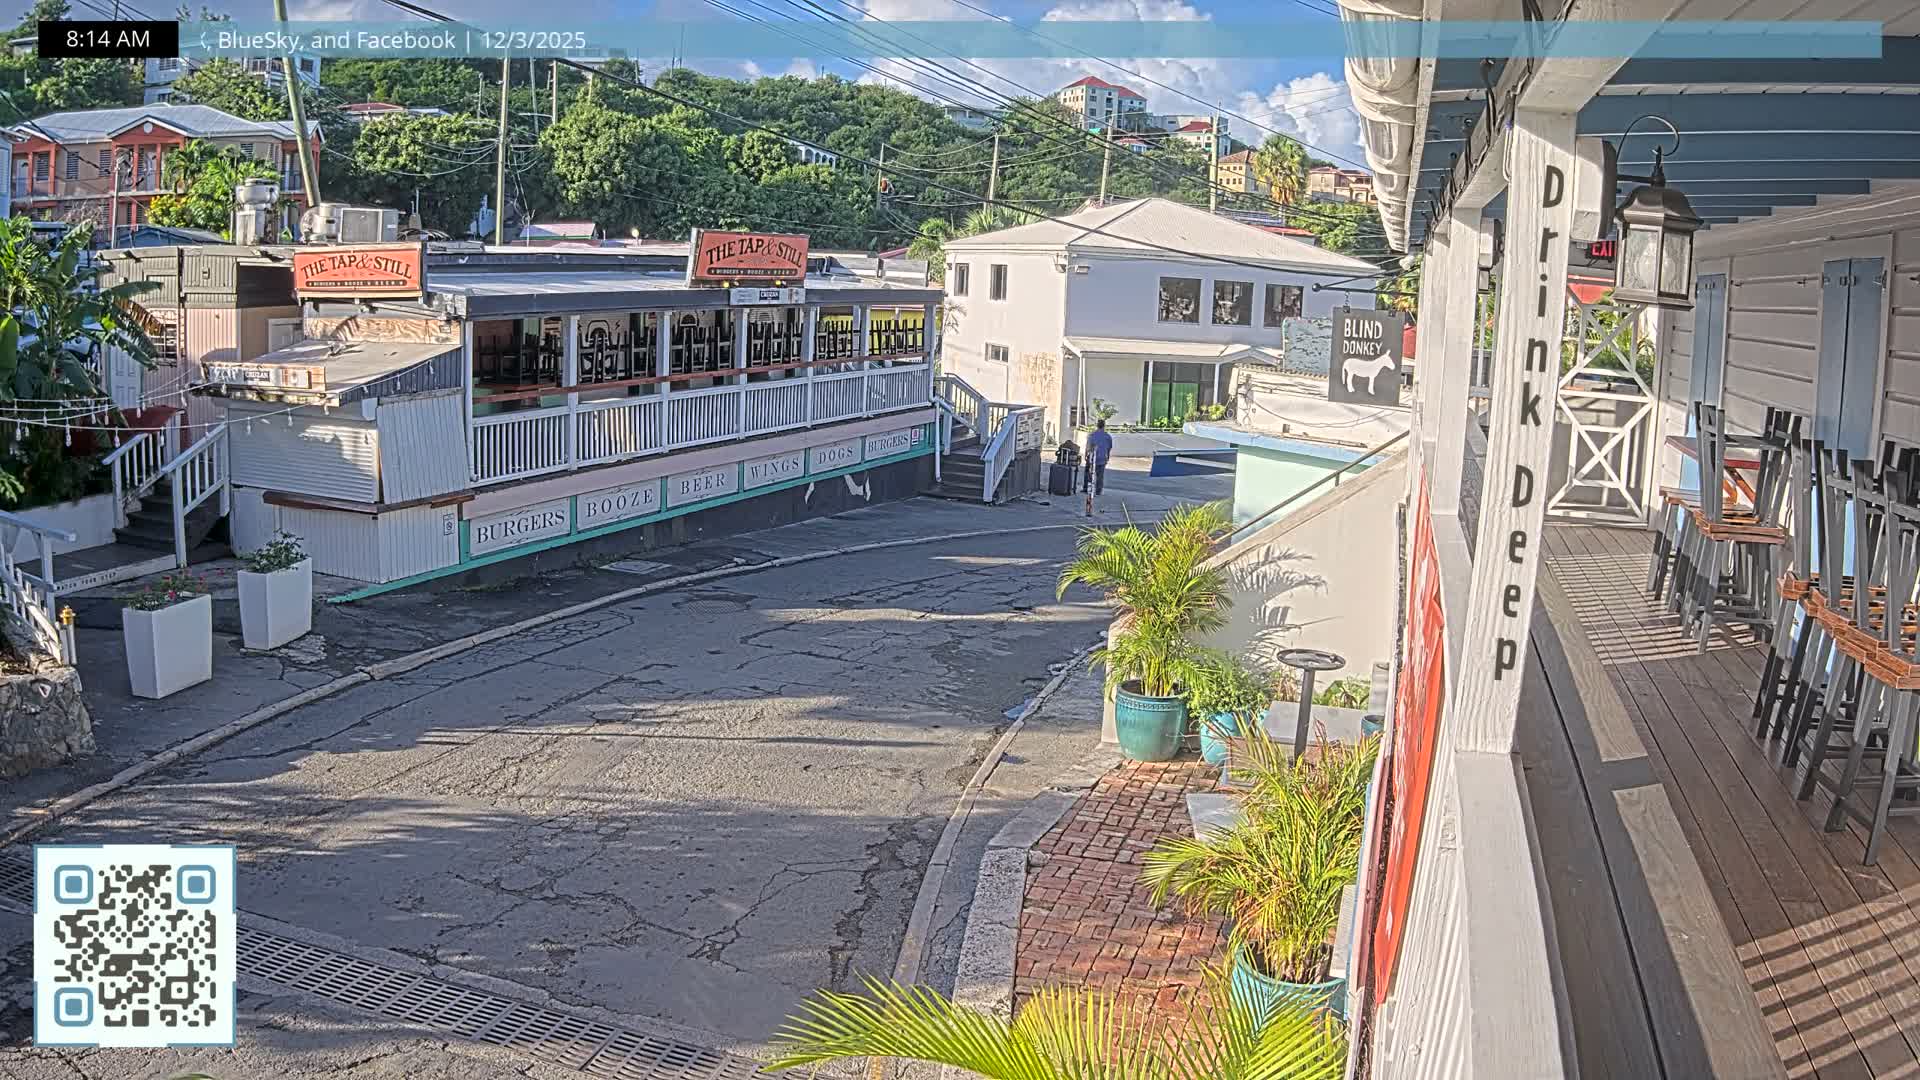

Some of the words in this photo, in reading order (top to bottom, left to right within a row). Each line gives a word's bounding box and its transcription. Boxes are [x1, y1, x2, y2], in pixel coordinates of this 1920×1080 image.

[706, 241, 736, 265] THE
[738, 237, 764, 255] TAP
[762, 238, 778, 256] &
[776, 241, 803, 268] STILL
[1592, 240, 1616, 257] EXI
[300, 258, 328, 280] THE
[328, 254, 357, 270] TAP
[355, 253, 373, 270] &
[373, 255, 412, 280] STILL
[1520, 164, 1565, 427] Drink
[1344, 318, 1383, 339] BLIND
[1343, 339, 1383, 356] DONKEY
[868, 434, 909, 453] BURGERS
[818, 447, 854, 465] DOGS
[750, 457, 800, 480] WINGS
[681, 472, 726, 495] BEER
[586, 488, 653, 518] BOOZE
[476, 509, 565, 544] BURGERS
[1494, 464, 1534, 681] Deep
